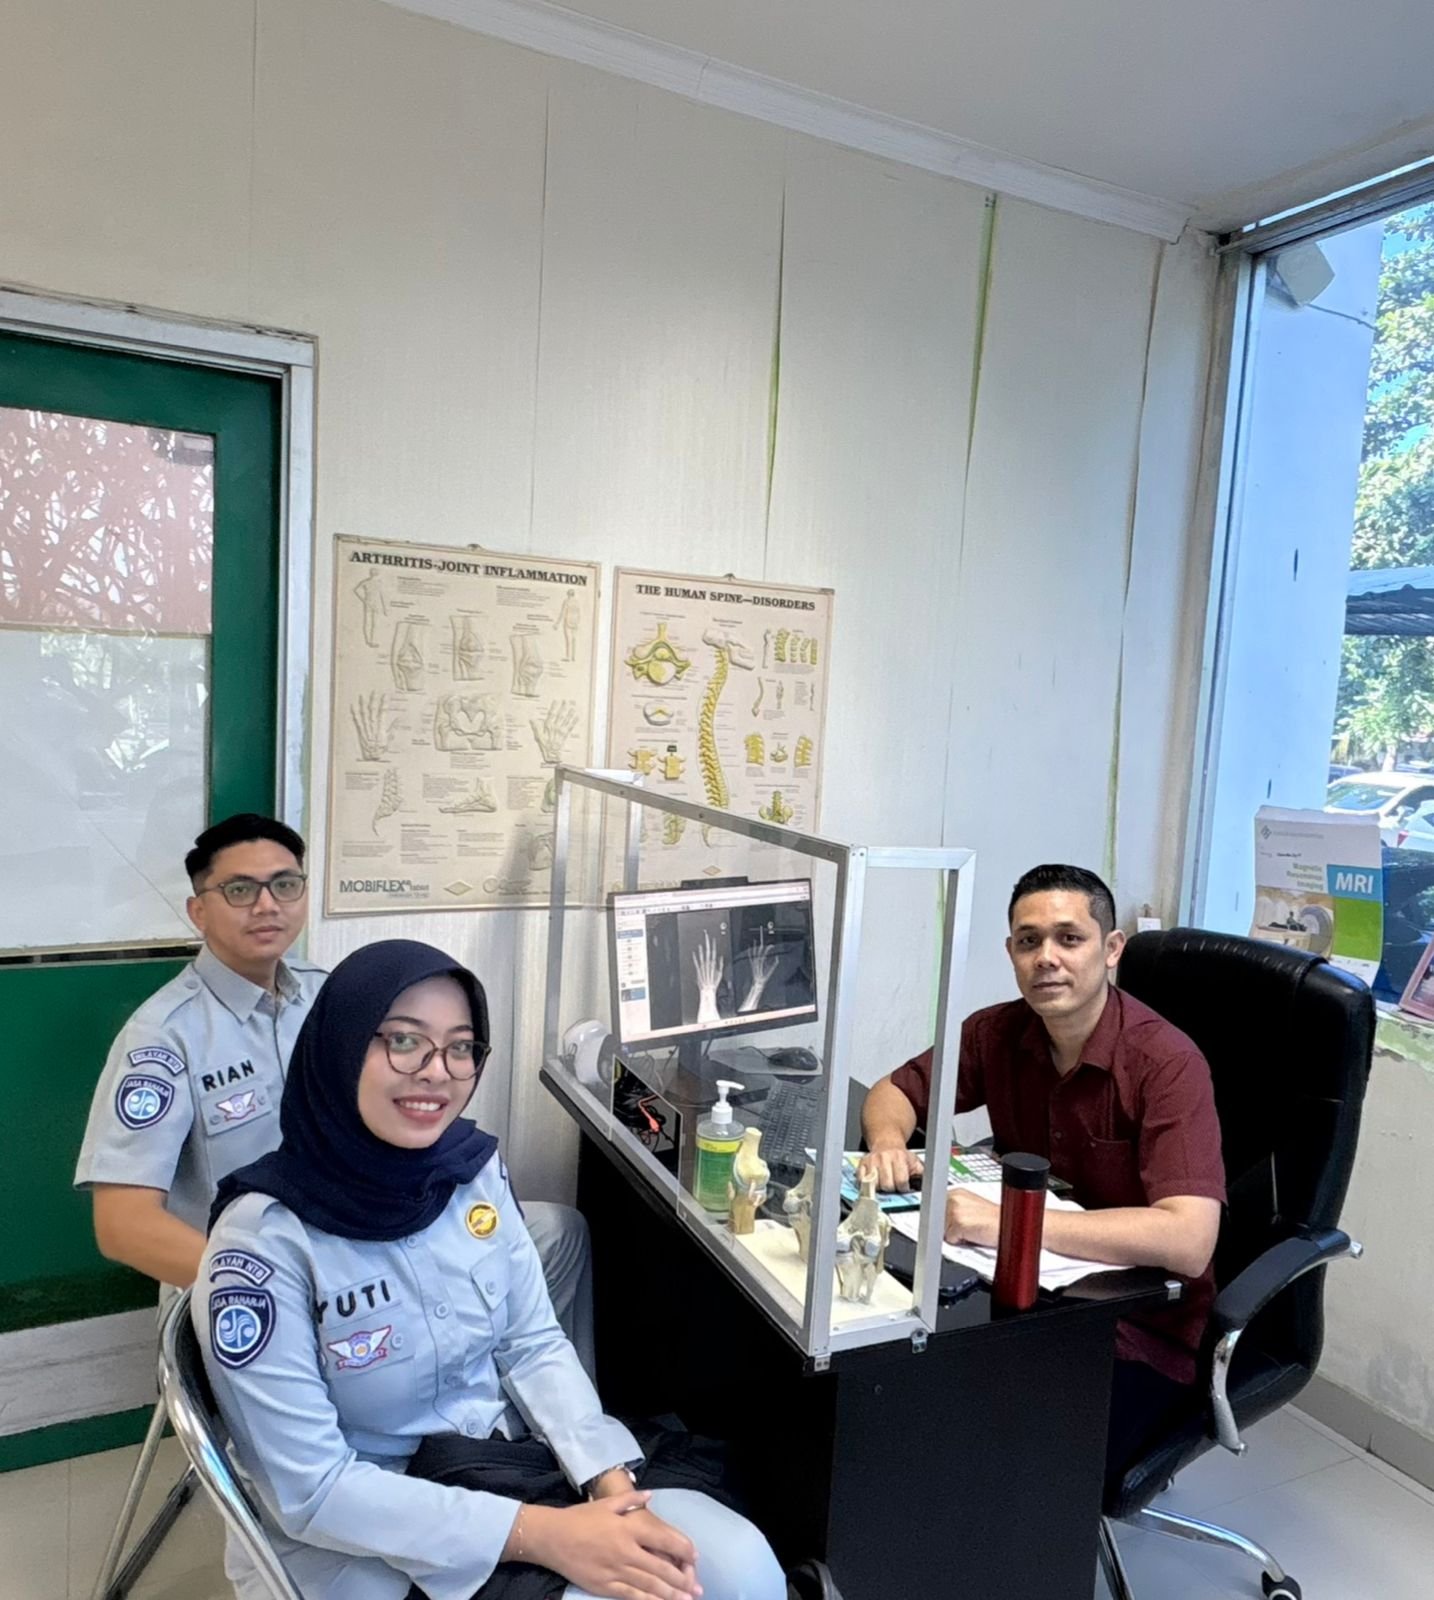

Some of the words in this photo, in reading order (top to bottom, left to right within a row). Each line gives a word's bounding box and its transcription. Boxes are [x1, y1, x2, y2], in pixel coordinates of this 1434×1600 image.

[350, 551, 480, 574] ARTHRITIS-JOINT
[484, 564, 588, 587] INFLAMMATION
[636, 584, 661, 596] THE
[664, 586, 706, 600] HUMAN
[339, 879, 405, 893] MOBIFLEX
[1335, 872, 1374, 894] MRI
[201, 1059, 255, 1092] RIAN
[245, 1261, 265, 1279] NTB
